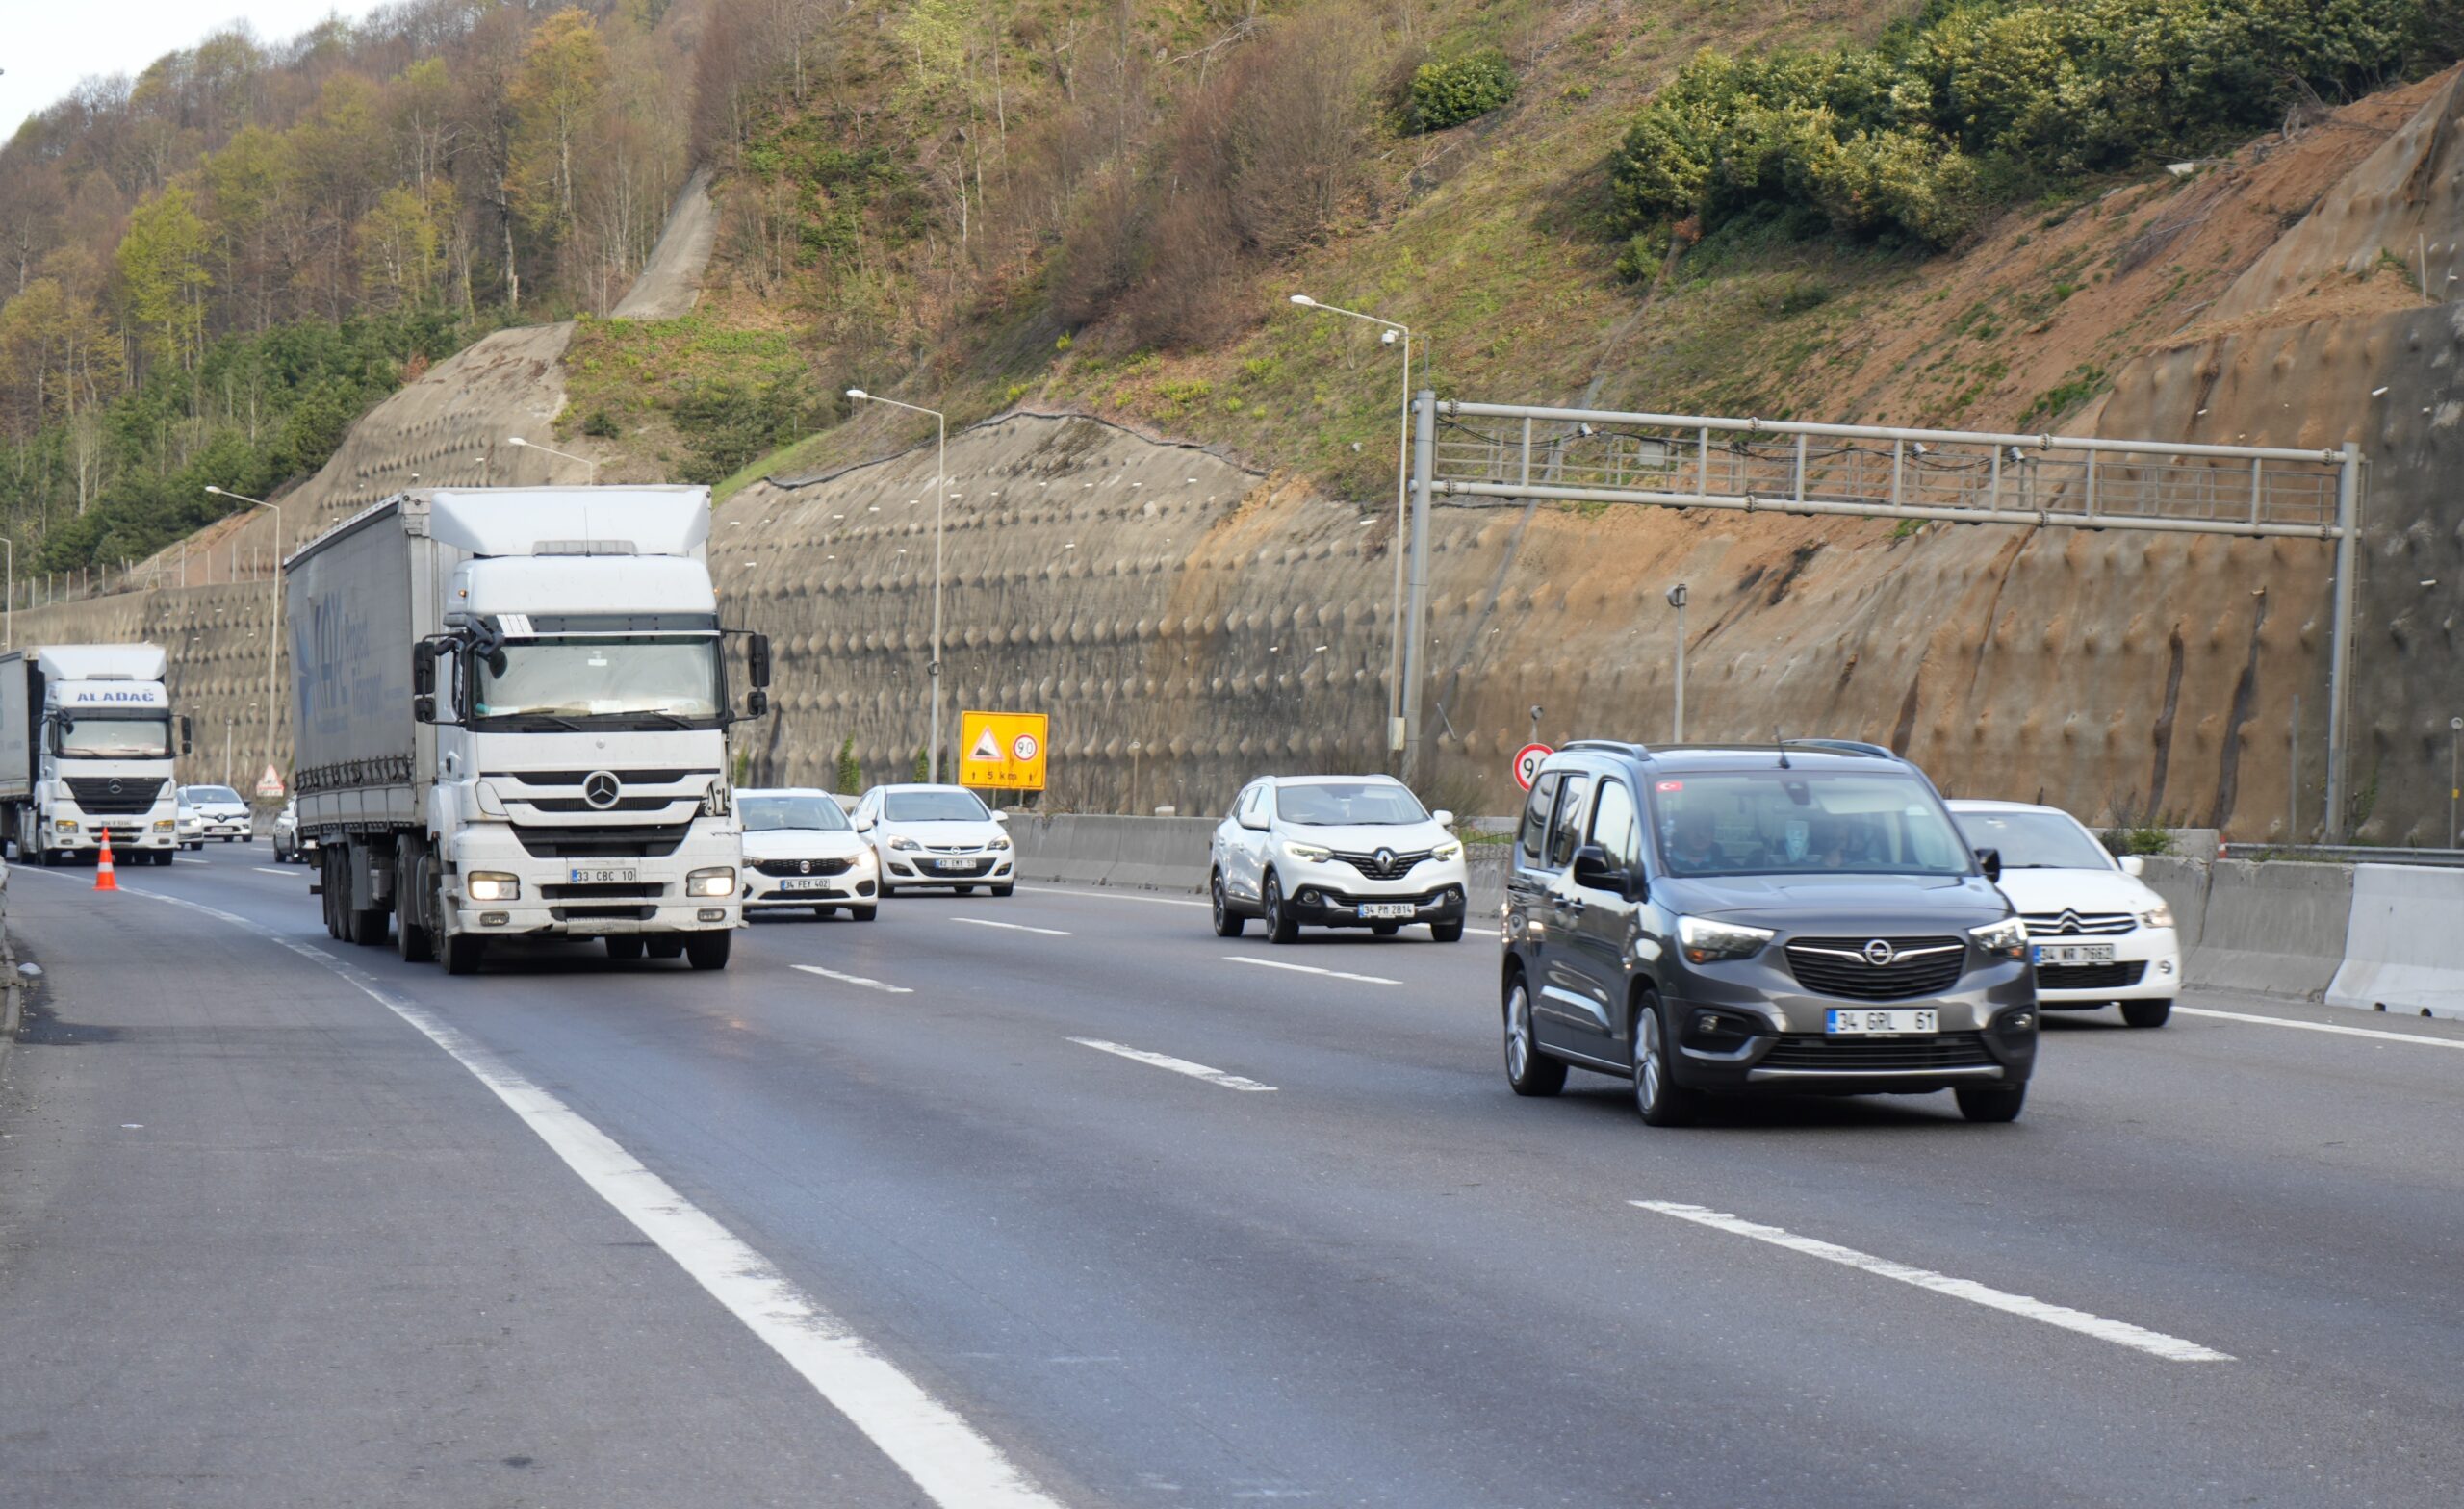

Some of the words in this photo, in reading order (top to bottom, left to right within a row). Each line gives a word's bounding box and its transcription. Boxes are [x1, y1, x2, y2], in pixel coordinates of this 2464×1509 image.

[77, 688, 155, 702] ALADAĞ
[1017, 741, 1034, 754] 90
[988, 771, 993, 780] 5
[1000, 771, 1017, 780] km
[578, 871, 589, 882] 33
[596, 871, 614, 882] CBC
[622, 870, 633, 881] 10
[785, 881, 794, 889] 34
[799, 880, 810, 889] FEY
[1364, 906, 1374, 914] 34
[1839, 1012, 1858, 1031] 34
[1868, 1012, 1896, 1031] GRL
[1916, 1011, 1934, 1030] 61
